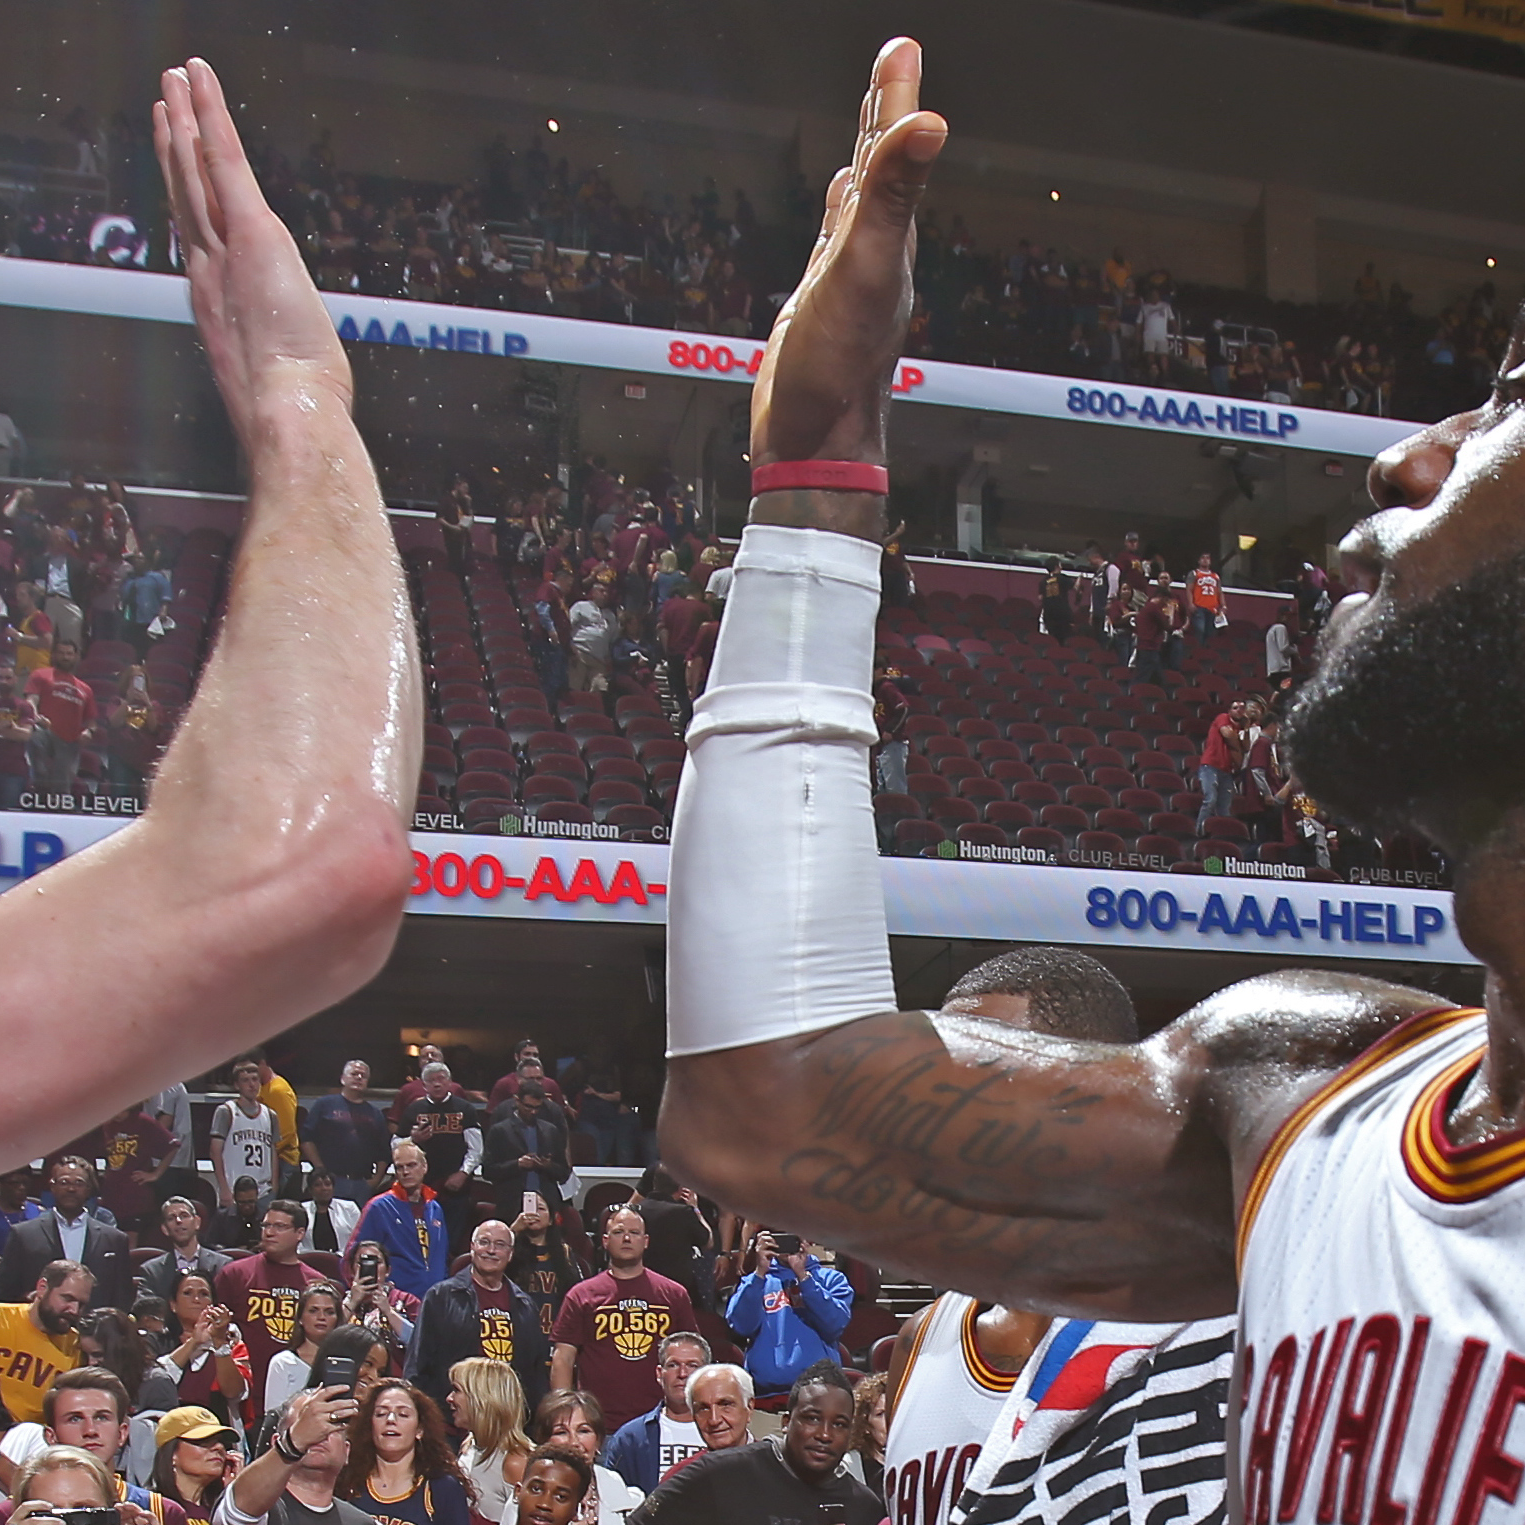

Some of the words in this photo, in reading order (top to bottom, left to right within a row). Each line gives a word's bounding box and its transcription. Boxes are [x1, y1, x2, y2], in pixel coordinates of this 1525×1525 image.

[1066, 387, 1299, 439] 800-AAA-HELP
[19, 792, 75, 811] CLUB
[81, 795, 145, 817] LEVEL
[411, 813, 463, 830] EVEL
[523, 814, 620, 841] Huntington
[959, 840, 1046, 863] Huntington
[1068, 849, 1114, 866] CLUB
[1118, 853, 1171, 870] LEVEL
[1225, 856, 1307, 880] Huntington
[1349, 866, 1391, 884] CLUB
[1395, 869, 1444, 886] LEVEL
[1085, 885, 1445, 946] 800-AAA-HELP
[243, 1144, 265, 1168] 23
[594, 1311, 671, 1341] 20.562
